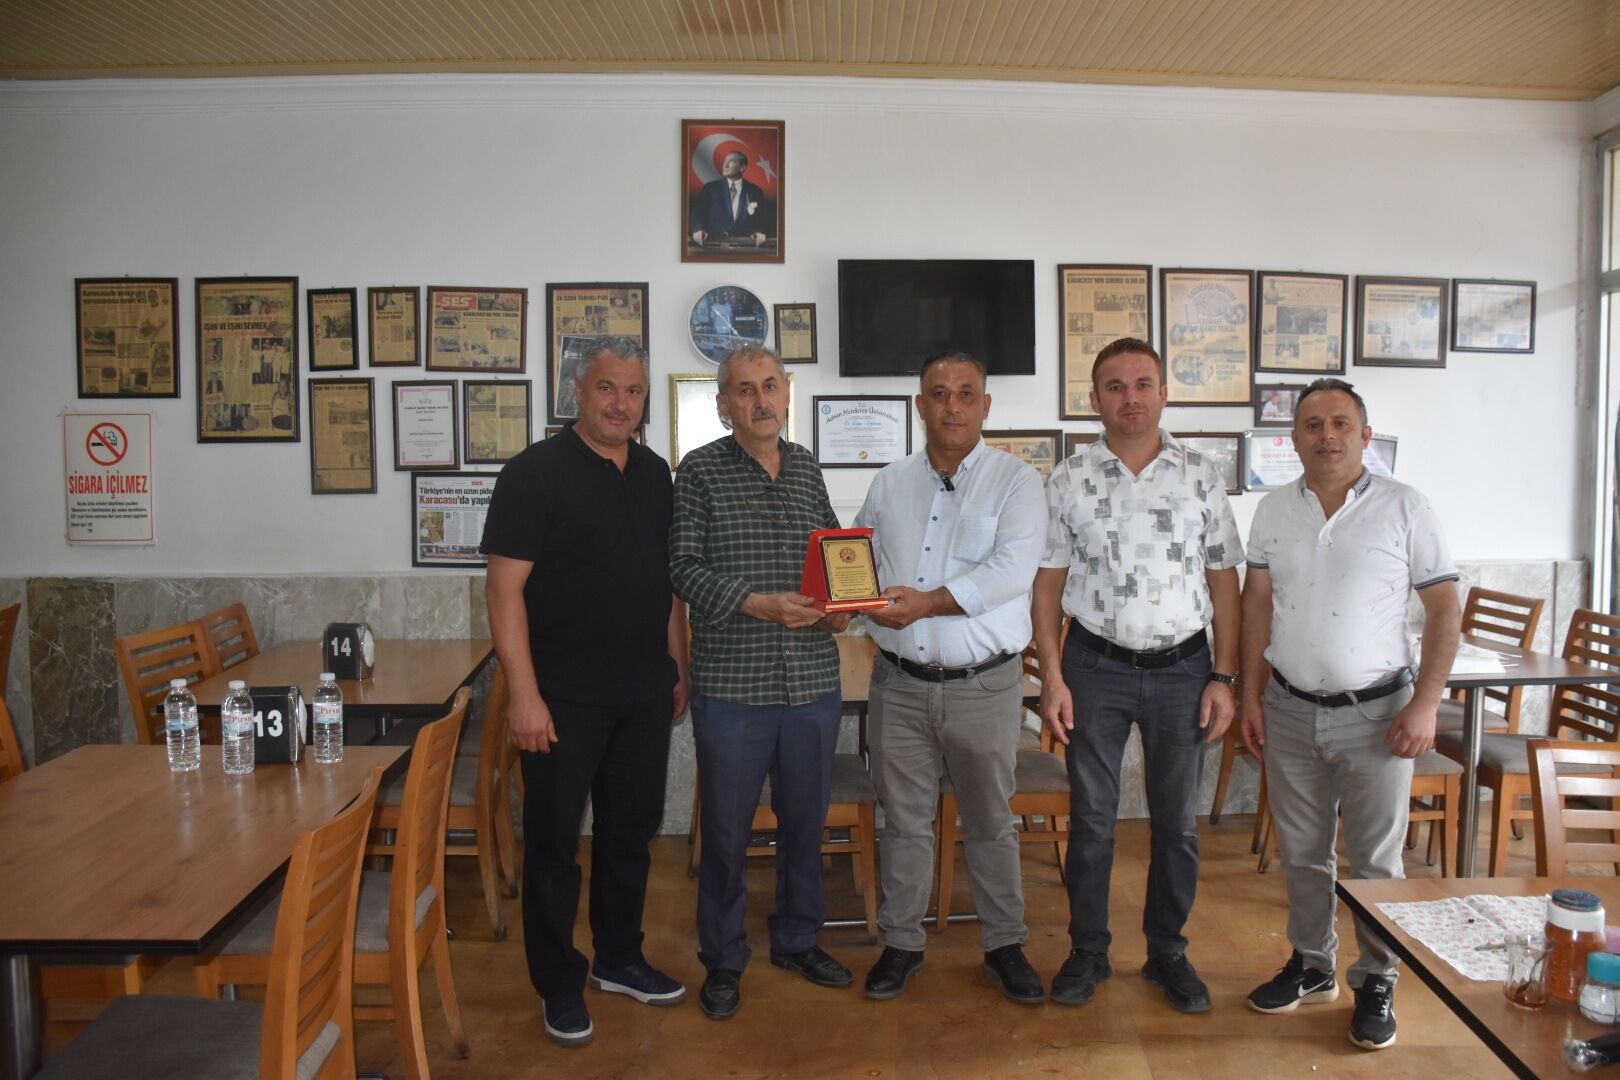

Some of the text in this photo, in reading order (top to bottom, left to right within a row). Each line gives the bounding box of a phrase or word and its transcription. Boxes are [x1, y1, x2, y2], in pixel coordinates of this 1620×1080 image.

[69, 470, 148, 499] SİGARA İÇİLMEZ
[420, 487, 454, 495] Türkiye'nin
[420, 495, 470, 505] Karacasu'da
[331, 636, 352, 657] 14
[253, 709, 284, 738] 13
